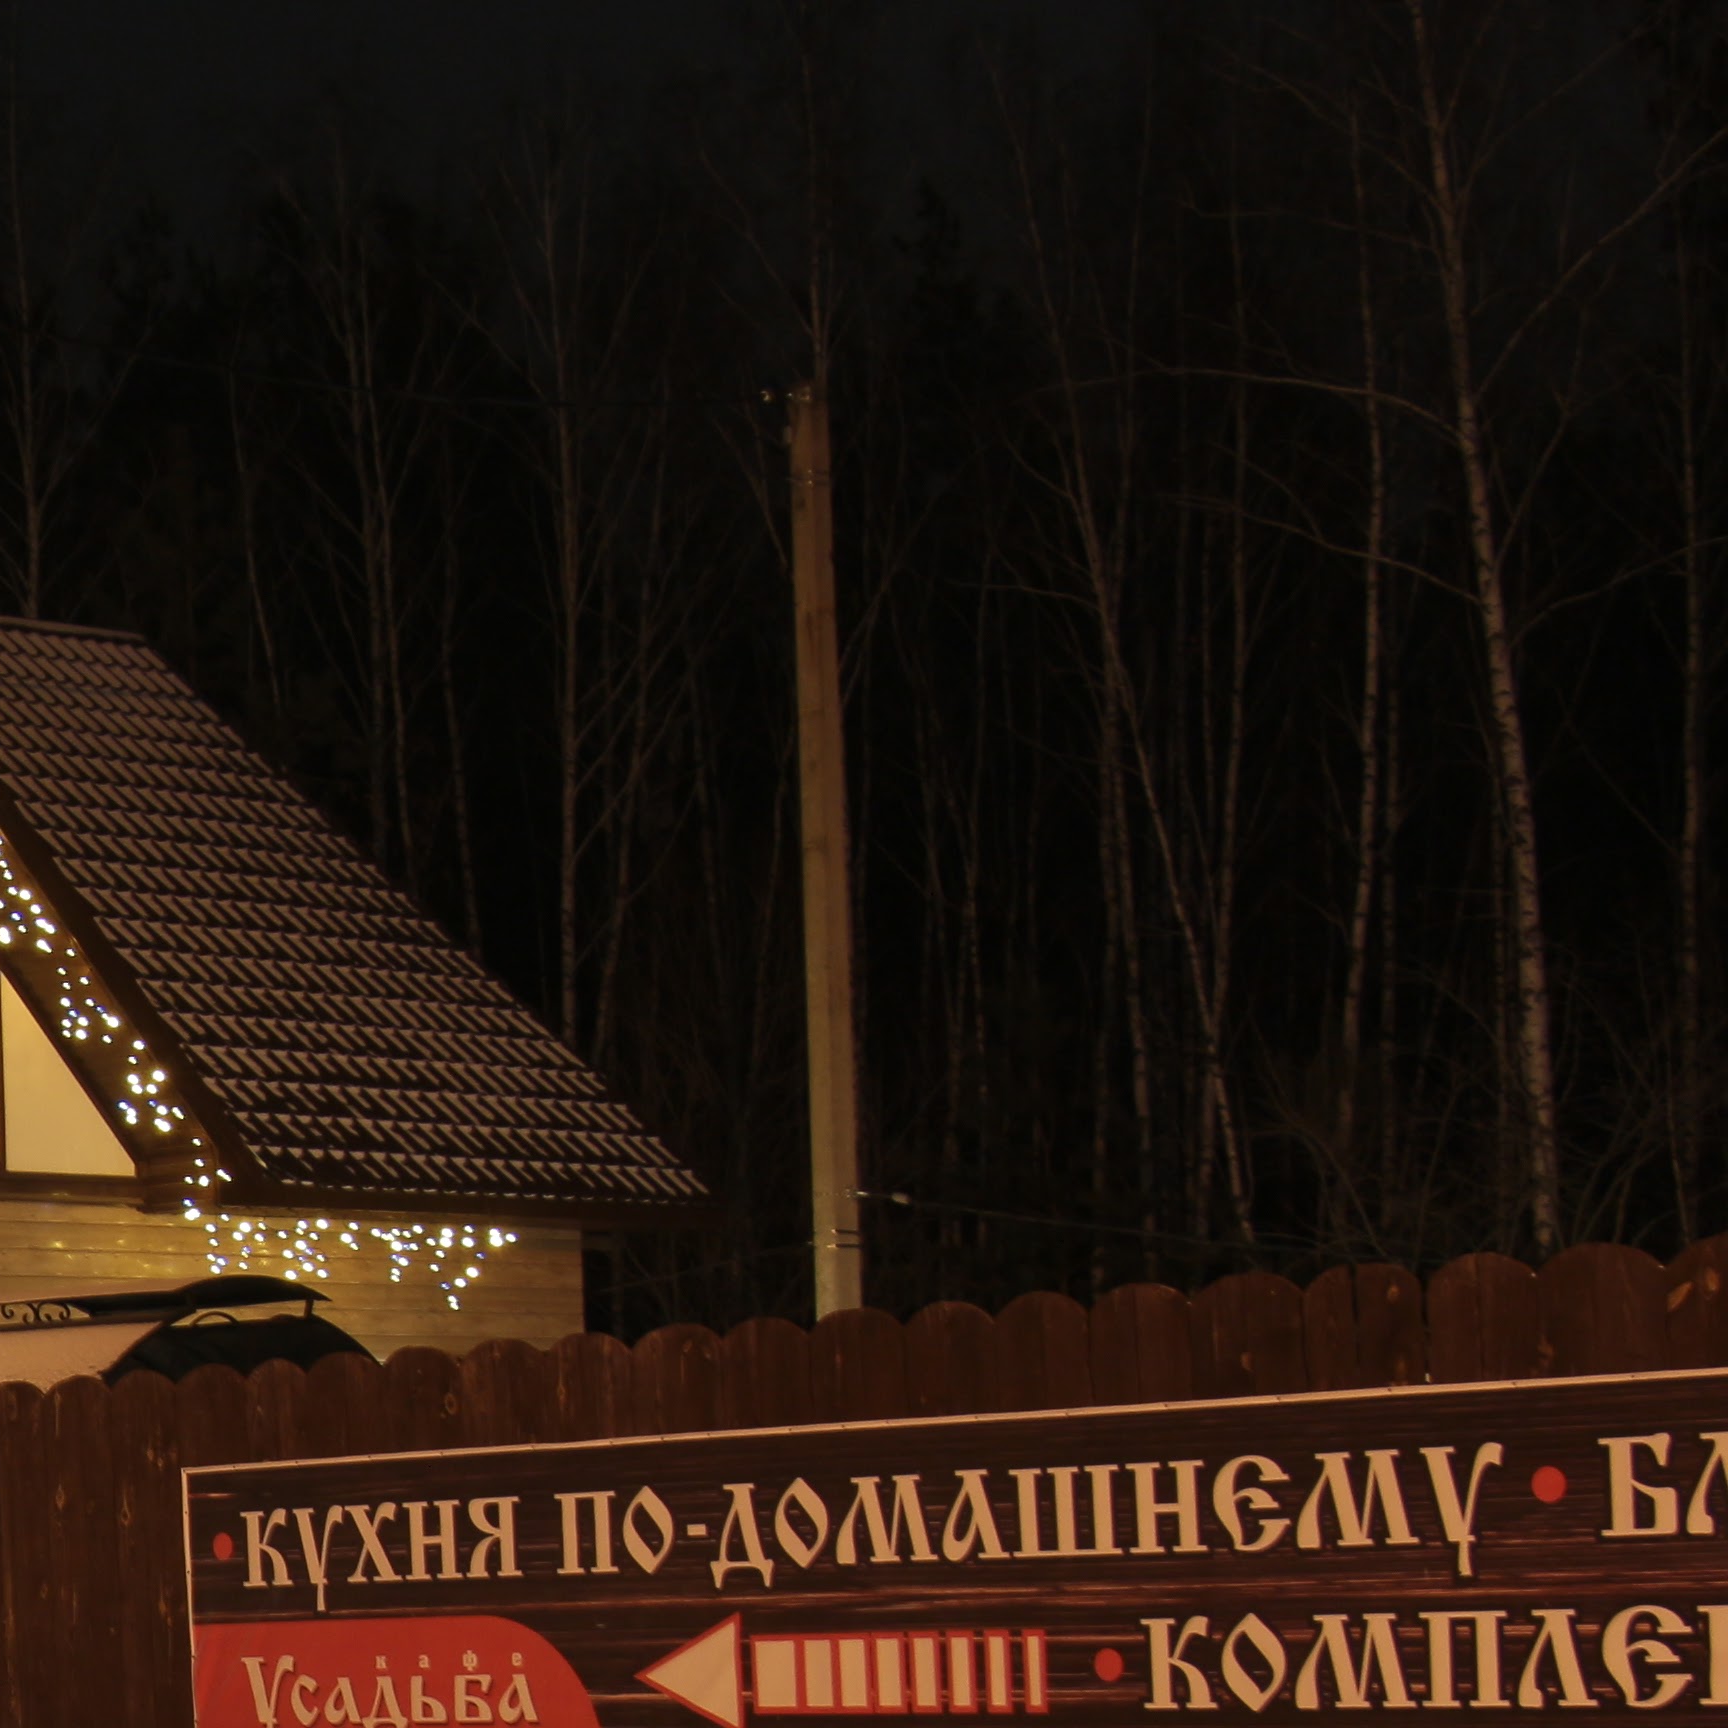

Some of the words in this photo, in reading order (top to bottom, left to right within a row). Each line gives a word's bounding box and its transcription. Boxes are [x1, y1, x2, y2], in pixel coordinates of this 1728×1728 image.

[241, 1496, 523, 1611] КУХНЯ
[555, 1442, 1502, 1577] ПО-ДОМАШНЕМУ
[1141, 1604, 1728, 1712] КОМПЛЕ
